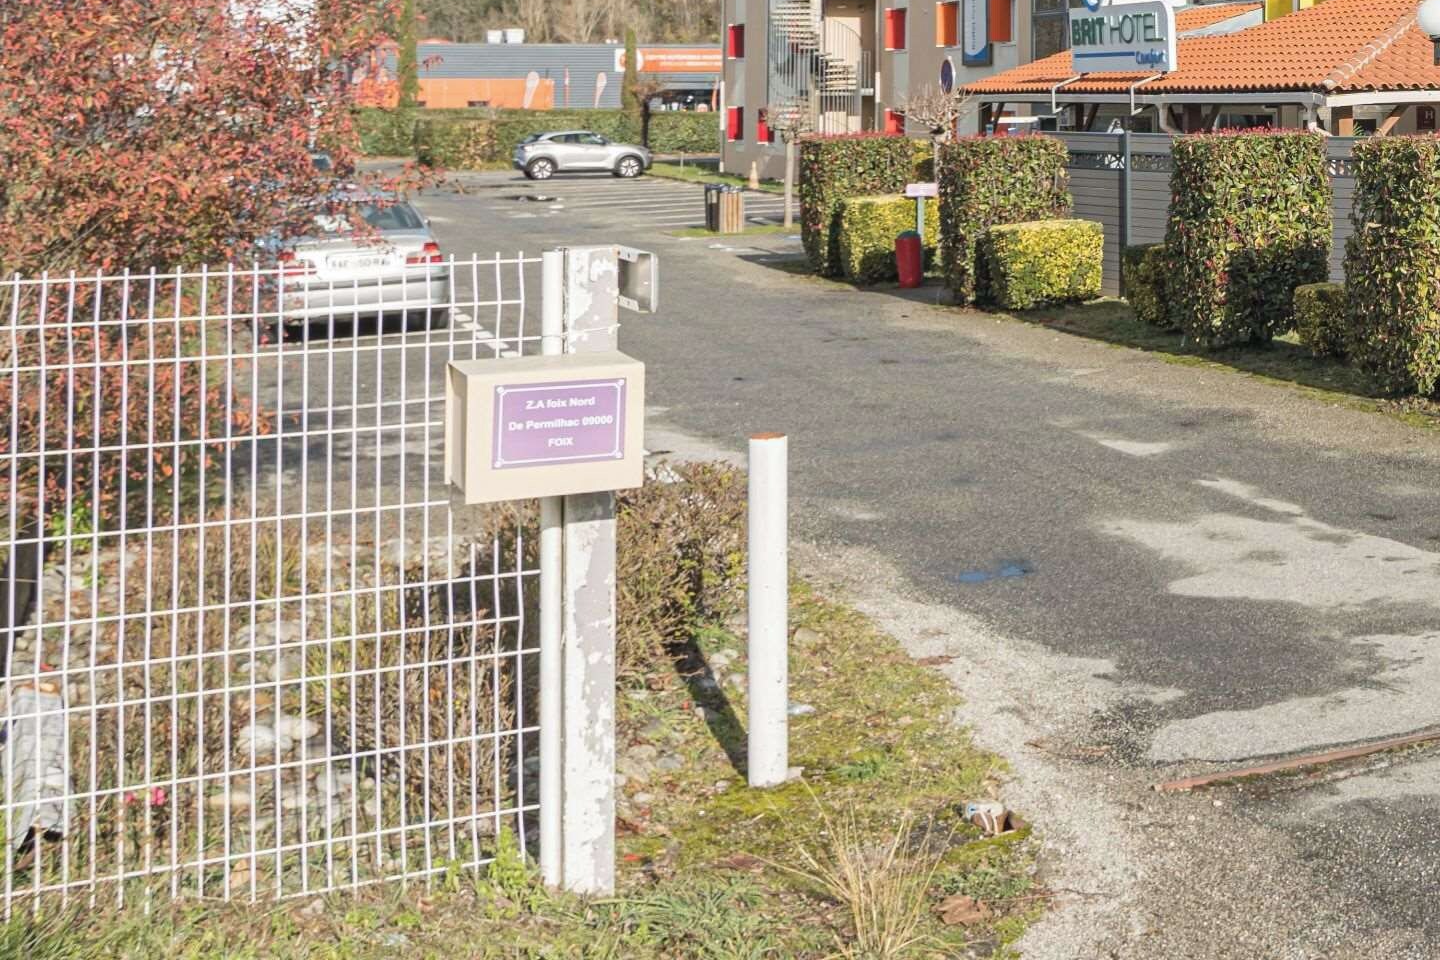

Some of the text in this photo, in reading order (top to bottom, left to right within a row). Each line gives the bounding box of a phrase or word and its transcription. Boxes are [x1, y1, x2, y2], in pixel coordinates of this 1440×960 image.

[1071, 12, 1165, 46] BRIT HOTEL
[569, 396, 596, 407] Nord
[508, 421, 524, 431] De
[548, 437, 574, 448] FOIX
